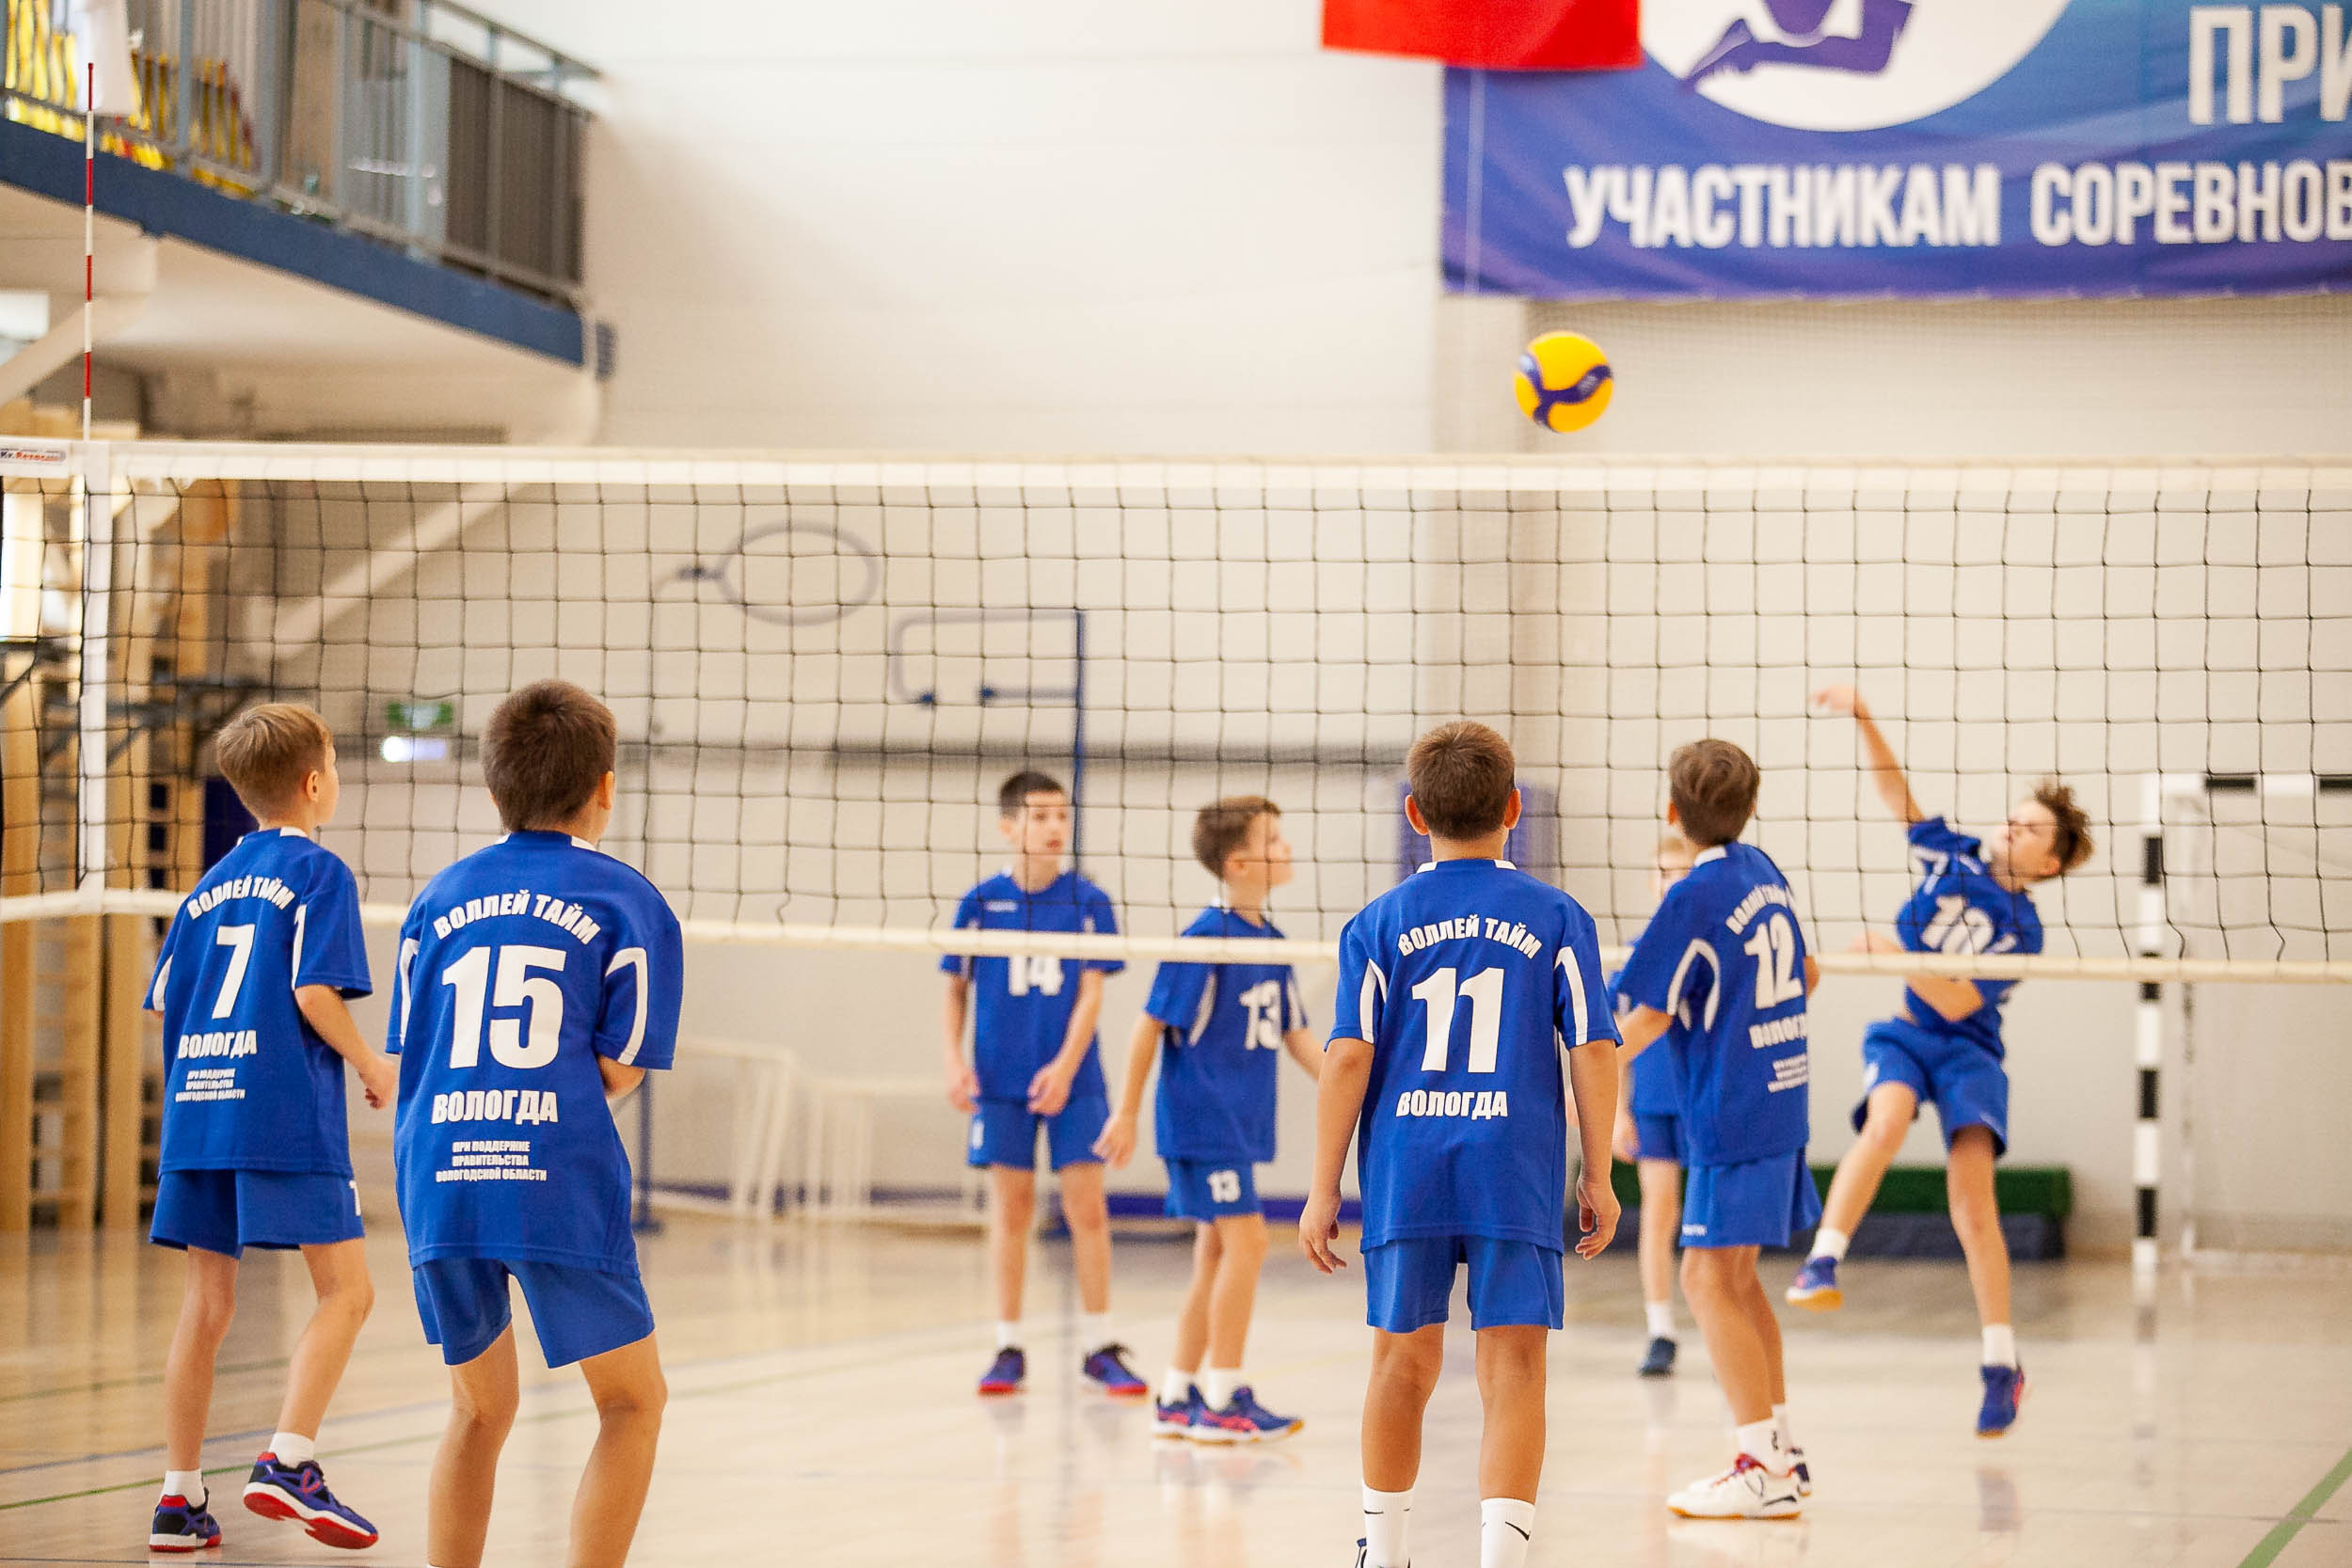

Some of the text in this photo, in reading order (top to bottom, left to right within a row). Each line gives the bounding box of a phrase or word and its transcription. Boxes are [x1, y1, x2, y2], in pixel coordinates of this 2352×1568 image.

[1563, 159, 2352, 248] УЧАСТНИКАМ СОРЕВНОВ
[187, 874, 295, 920] ВОЛЛЕЙ ТАЙМ
[433, 889, 601, 945] ВОЛЛЕЙ ТАЙМ
[1397, 914, 1543, 959] ВОЛЛЕЙ ТАЙМ
[1743, 912, 1803, 1009] 12
[212, 923, 256, 1020] 7
[441, 944, 566, 1069] 15
[1411, 967, 1505, 1073] 11
[178, 1030, 257, 1059] ВОЛОГДА
[431, 1089, 559, 1126] ВОЛОГДА
[1395, 1089, 1508, 1120] ВОЛОГДА
